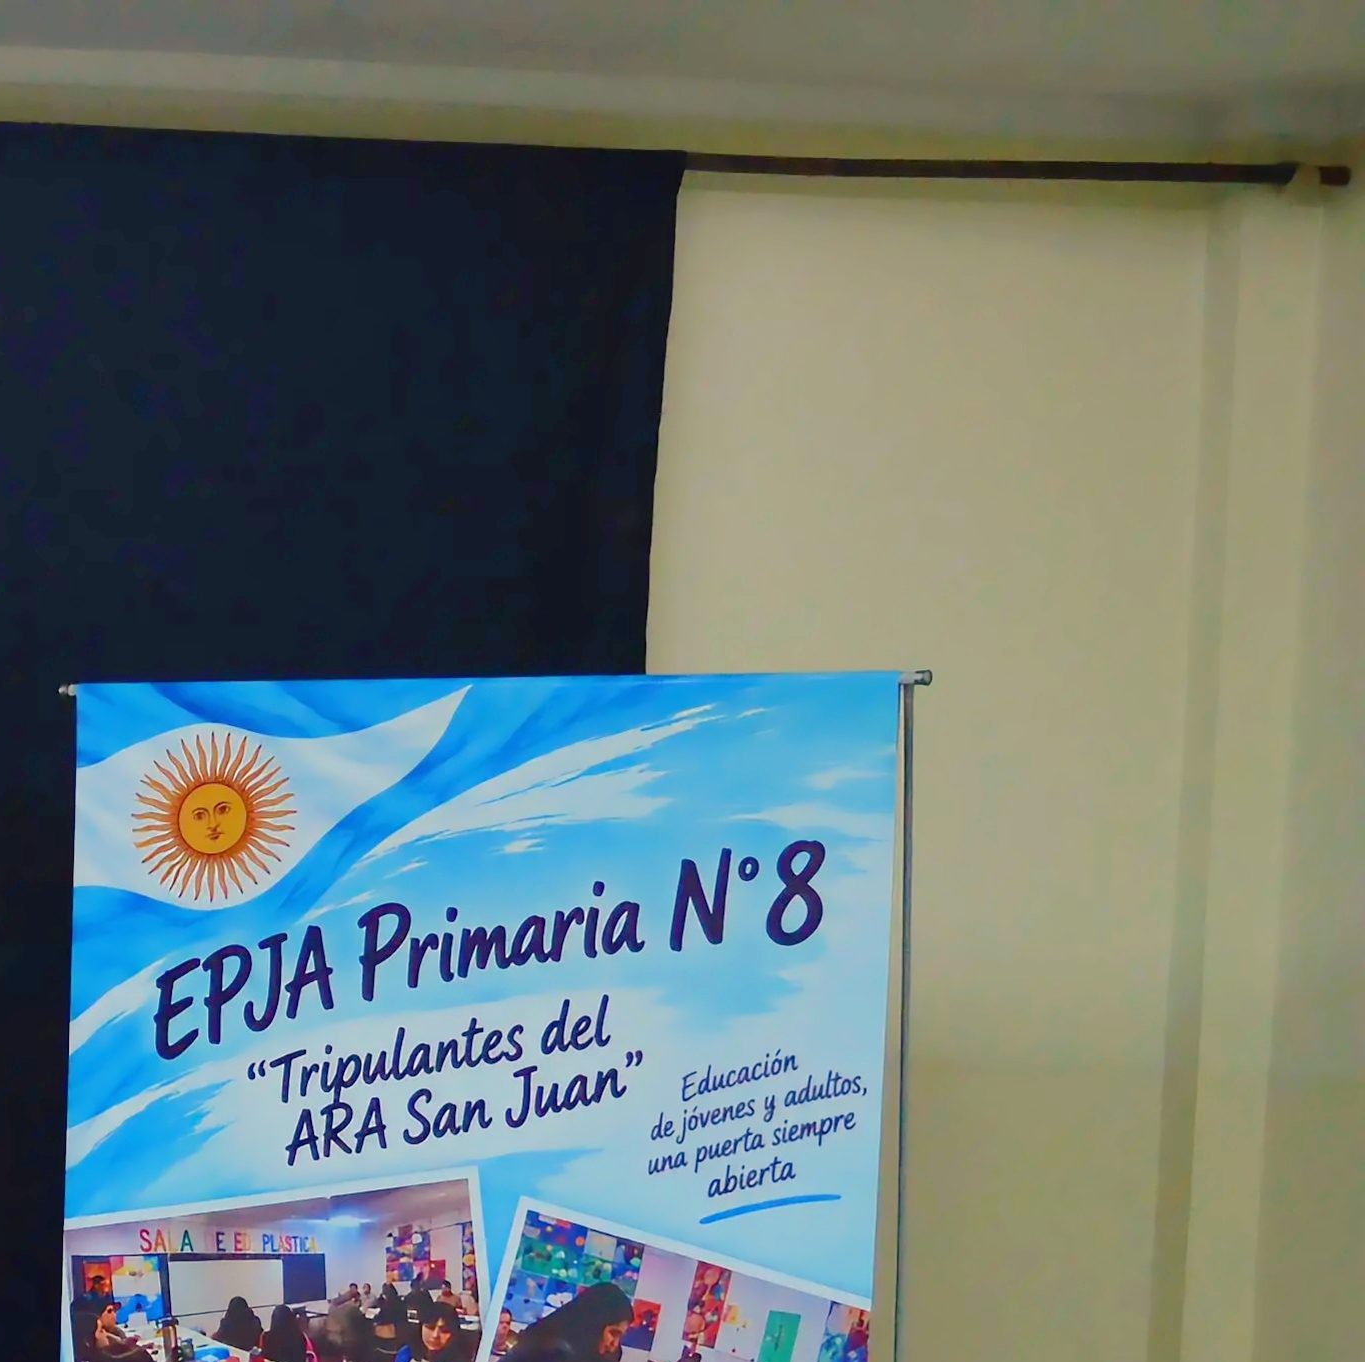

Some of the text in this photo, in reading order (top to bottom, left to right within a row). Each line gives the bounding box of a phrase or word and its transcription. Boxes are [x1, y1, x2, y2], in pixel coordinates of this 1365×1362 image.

[153, 925, 335, 1060] EPJA
[357, 880, 646, 1003] Primaria
[541, 994, 611, 1052] del
[650, 1072, 870, 1147] de jóvenes y adultos,
[681, 1049, 800, 1103] Educación
[287, 1097, 388, 1167] ARA
[403, 1085, 493, 1146] San
[647, 1109, 858, 1180] una puerta siempre
[706, 1157, 798, 1201] abierta
